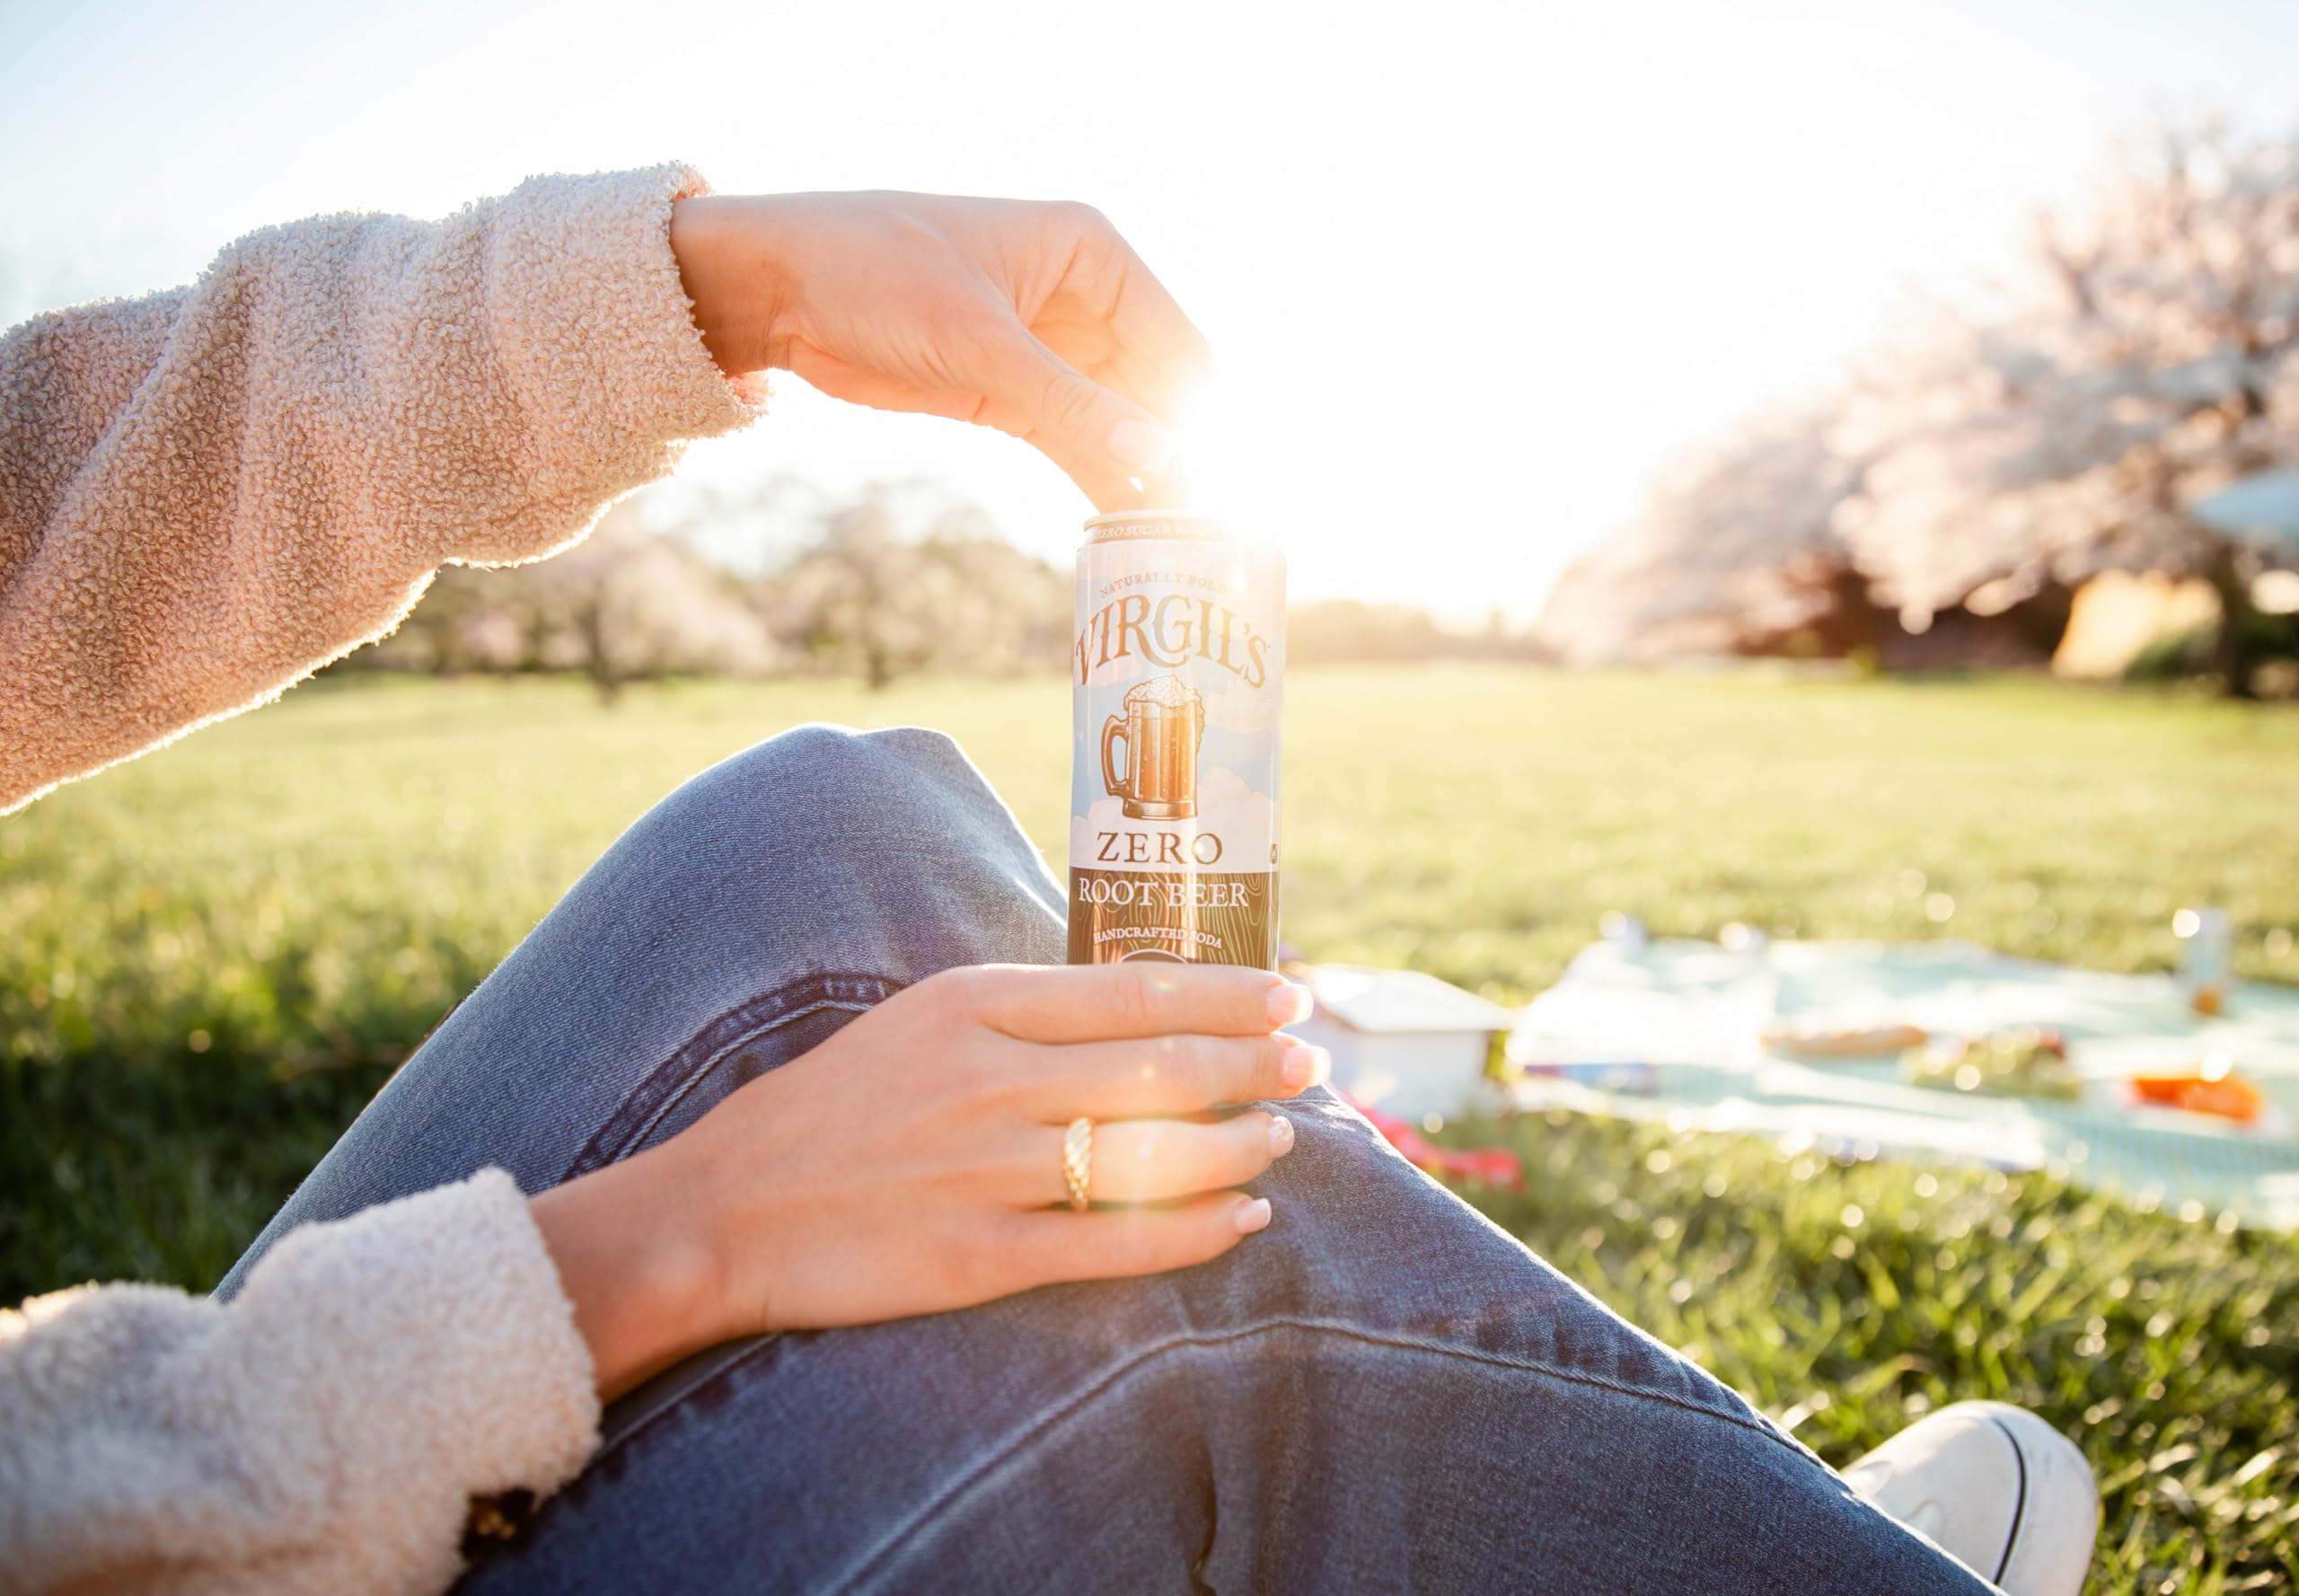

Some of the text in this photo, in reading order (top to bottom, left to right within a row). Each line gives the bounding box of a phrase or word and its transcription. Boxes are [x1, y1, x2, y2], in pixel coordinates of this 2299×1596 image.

[1099, 571, 1184, 598] NATURALLY
[1076, 594, 1271, 689] VIRGIL'S
[1097, 831, 1223, 865] ZERO
[1079, 877, 1249, 908] ROOT BEER
[1093, 926, 1222, 949] HANDCRAFTED SODA
